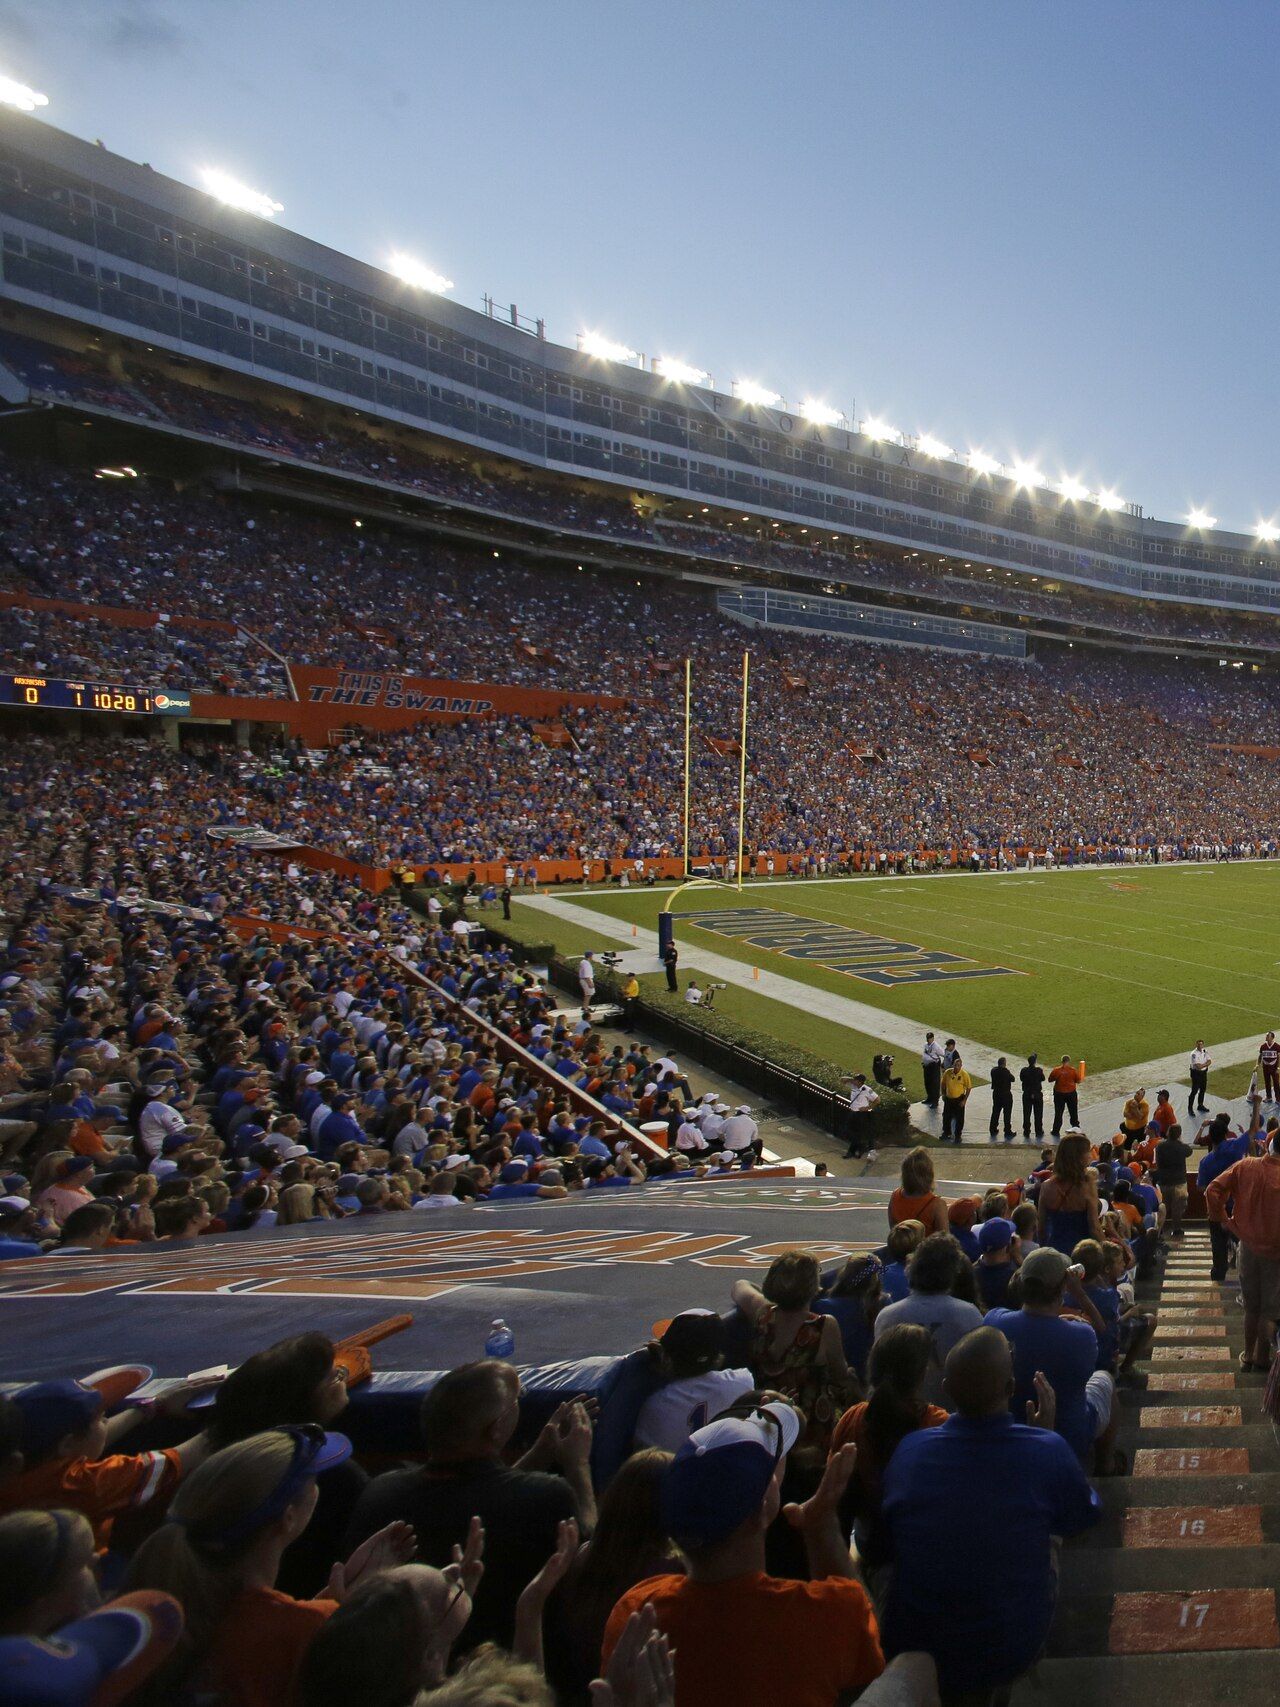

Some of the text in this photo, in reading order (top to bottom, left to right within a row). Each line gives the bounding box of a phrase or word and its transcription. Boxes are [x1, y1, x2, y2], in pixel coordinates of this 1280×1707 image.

[338, 672, 384, 692] THIS
[26, 687, 38, 704] 0
[76, 692, 82, 706] 1
[145, 698, 150, 711] 1
[309, 685, 493, 714] THE SWAMP
[1183, 1412, 1201, 1423] 14
[1179, 1455, 1200, 1469] 15
[1179, 1519, 1206, 1536] 16
[1178, 1603, 1210, 1629] 17
